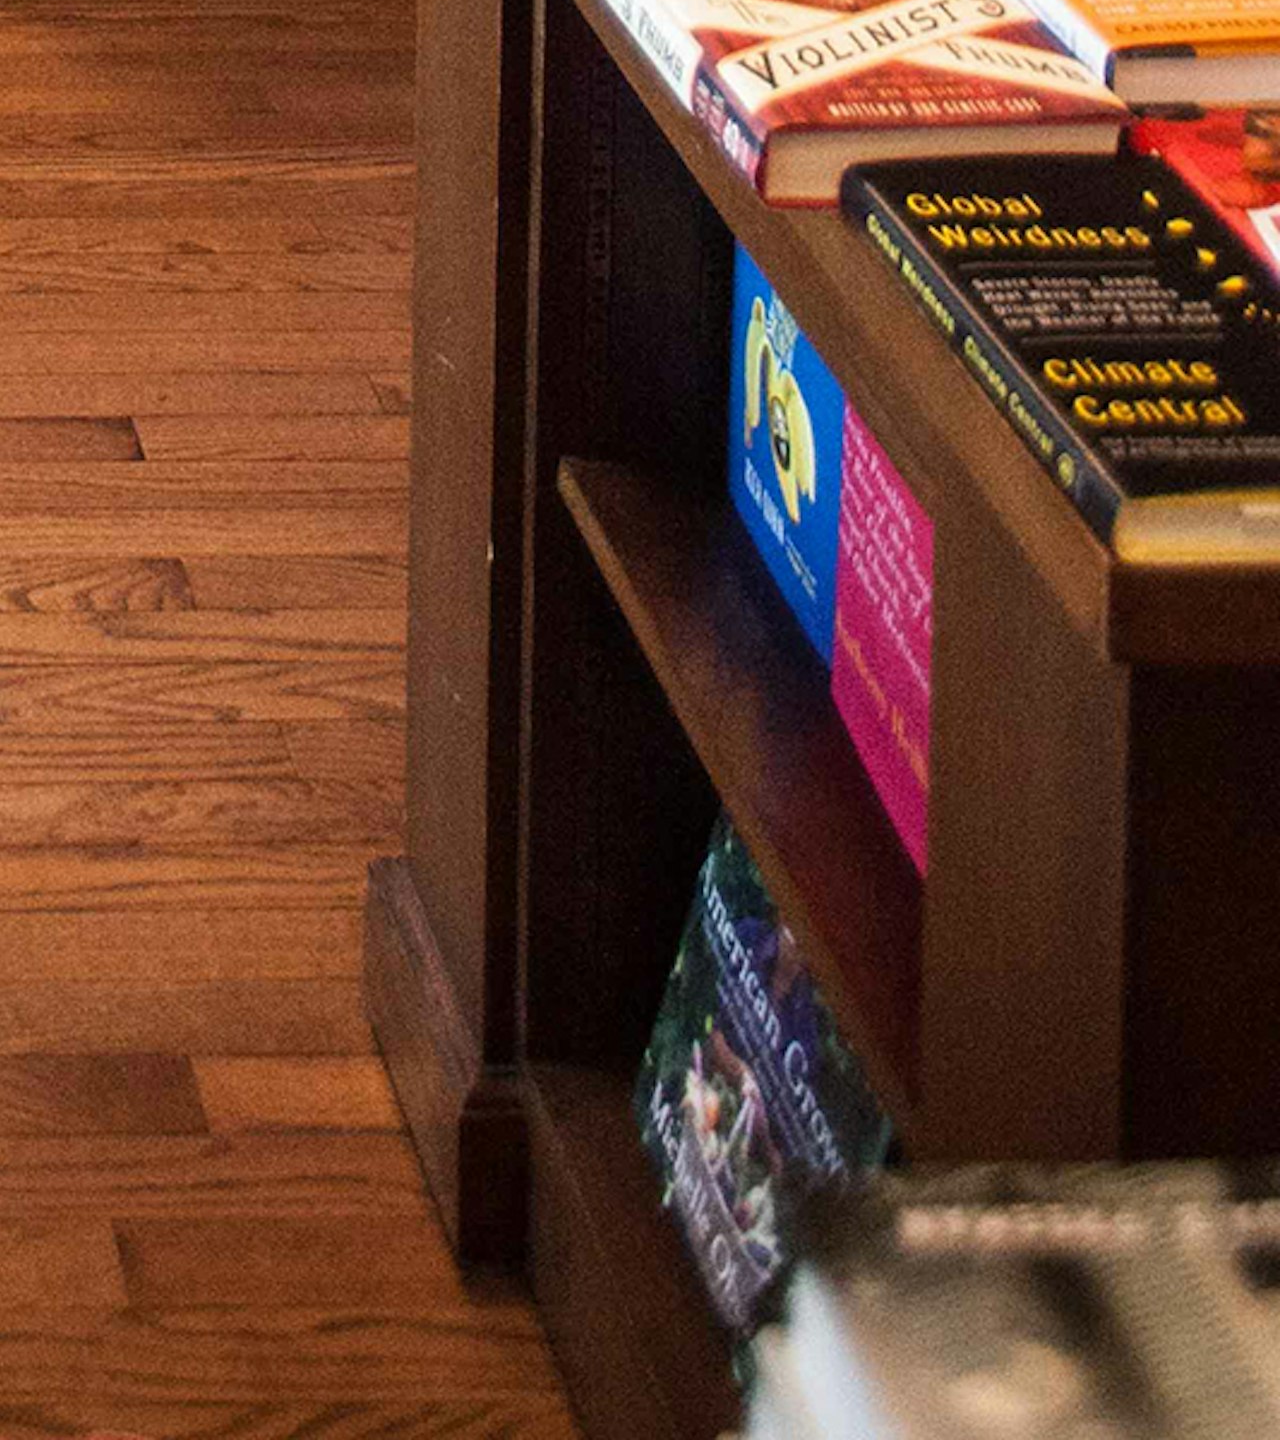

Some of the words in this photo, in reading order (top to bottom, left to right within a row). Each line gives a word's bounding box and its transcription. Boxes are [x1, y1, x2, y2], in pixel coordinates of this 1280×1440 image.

[905, 192, 1043, 219] Global
[928, 223, 1150, 249] Weirdness
[1043, 357, 1217, 387] Climate
[1074, 396, 1245, 426] Central
